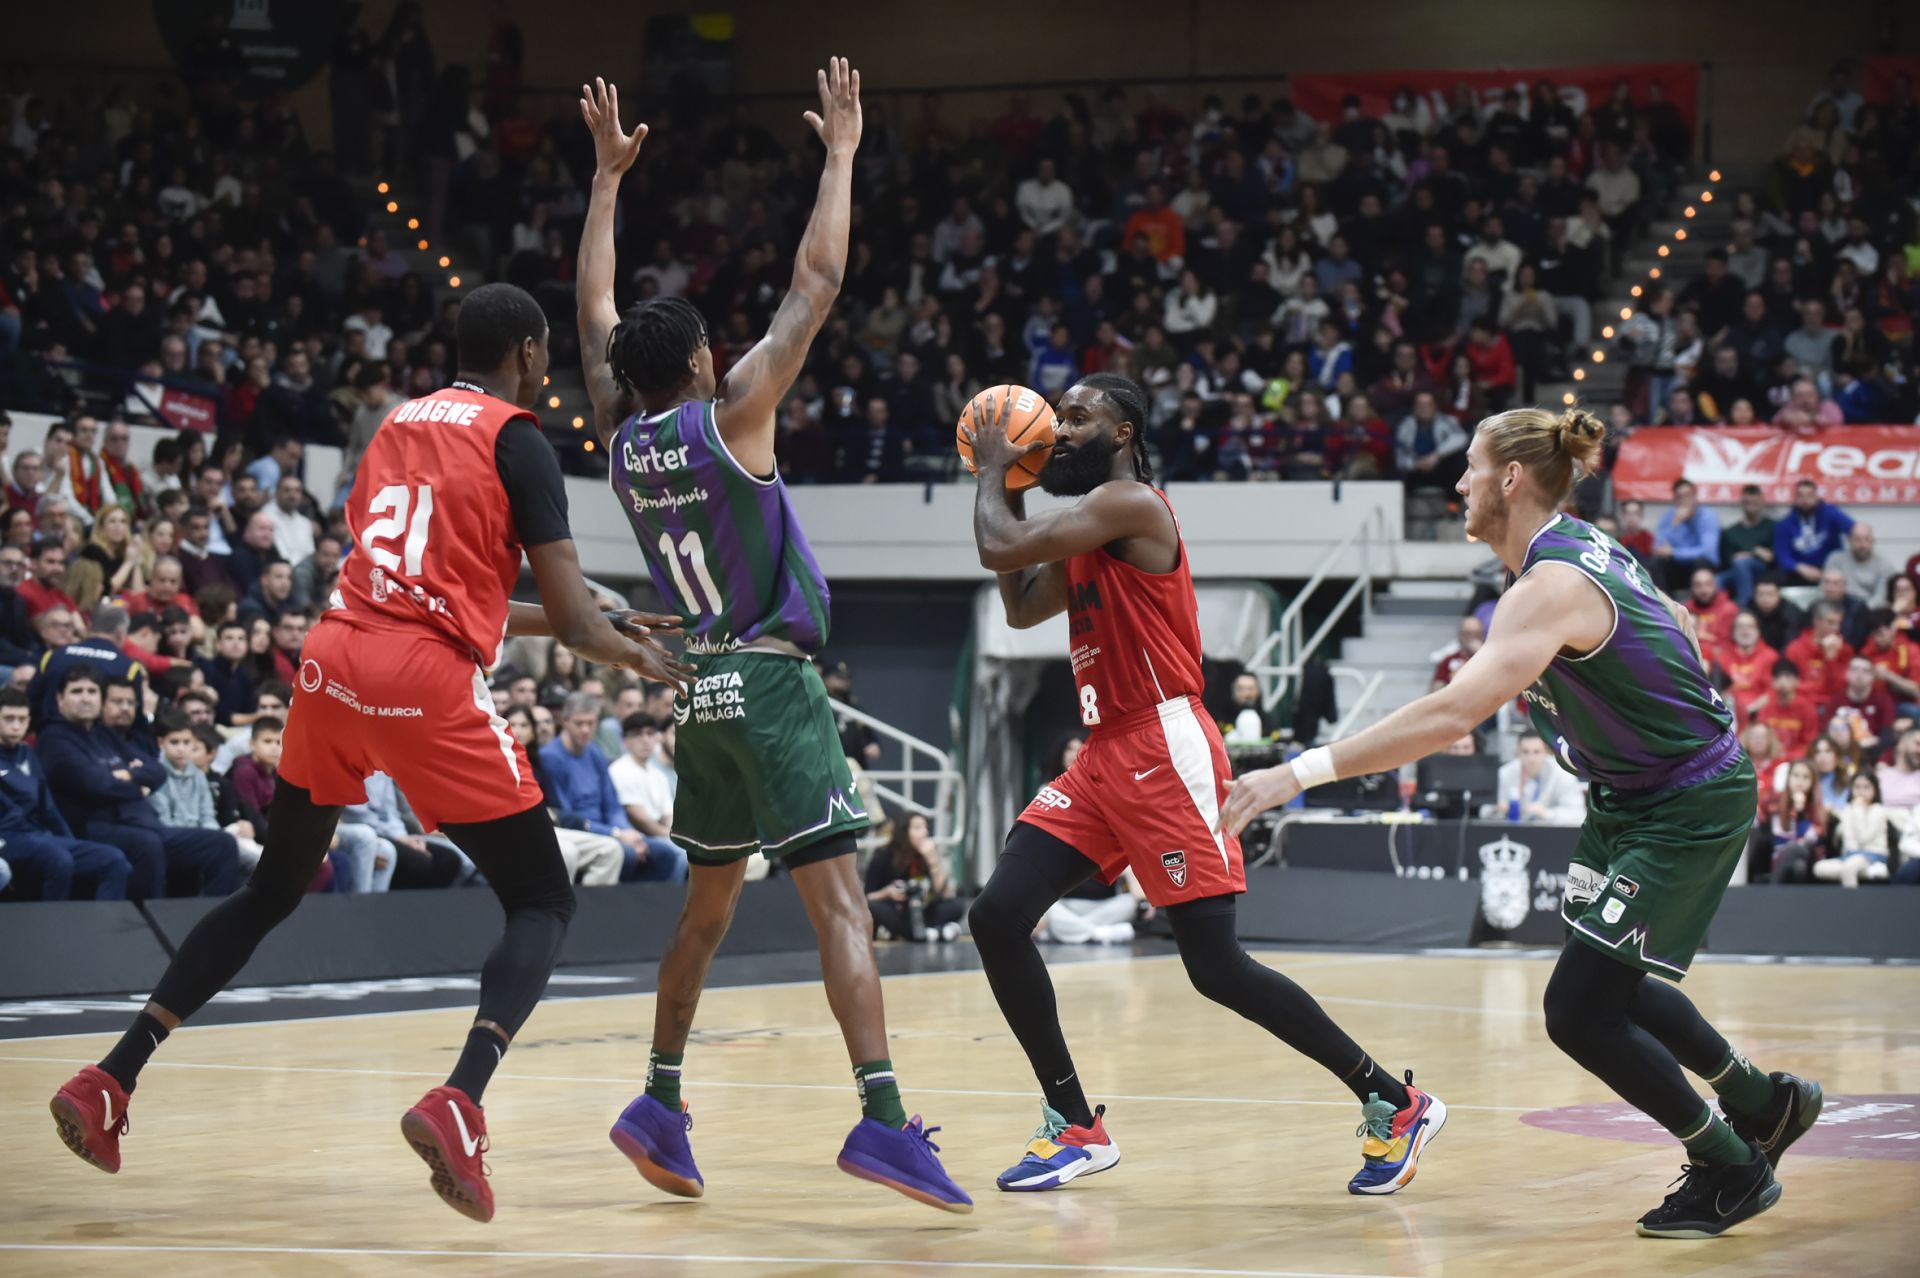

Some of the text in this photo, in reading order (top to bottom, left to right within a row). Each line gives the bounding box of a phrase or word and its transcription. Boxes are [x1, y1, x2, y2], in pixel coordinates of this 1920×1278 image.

[394, 401, 484, 426] DIAGNE
[623, 442, 689, 473] Carter
[361, 484, 434, 577] 21
[659, 531, 723, 616] 11
[694, 671, 743, 694] COSTA
[362, 705, 376, 715] DE
[377, 707, 423, 717] MURCIA
[692, 689, 745, 710] DEL SOL
[1080, 684, 1101, 725] 8
[695, 705, 746, 724] MÁLAGA
[1615, 882, 1632, 894] acb
